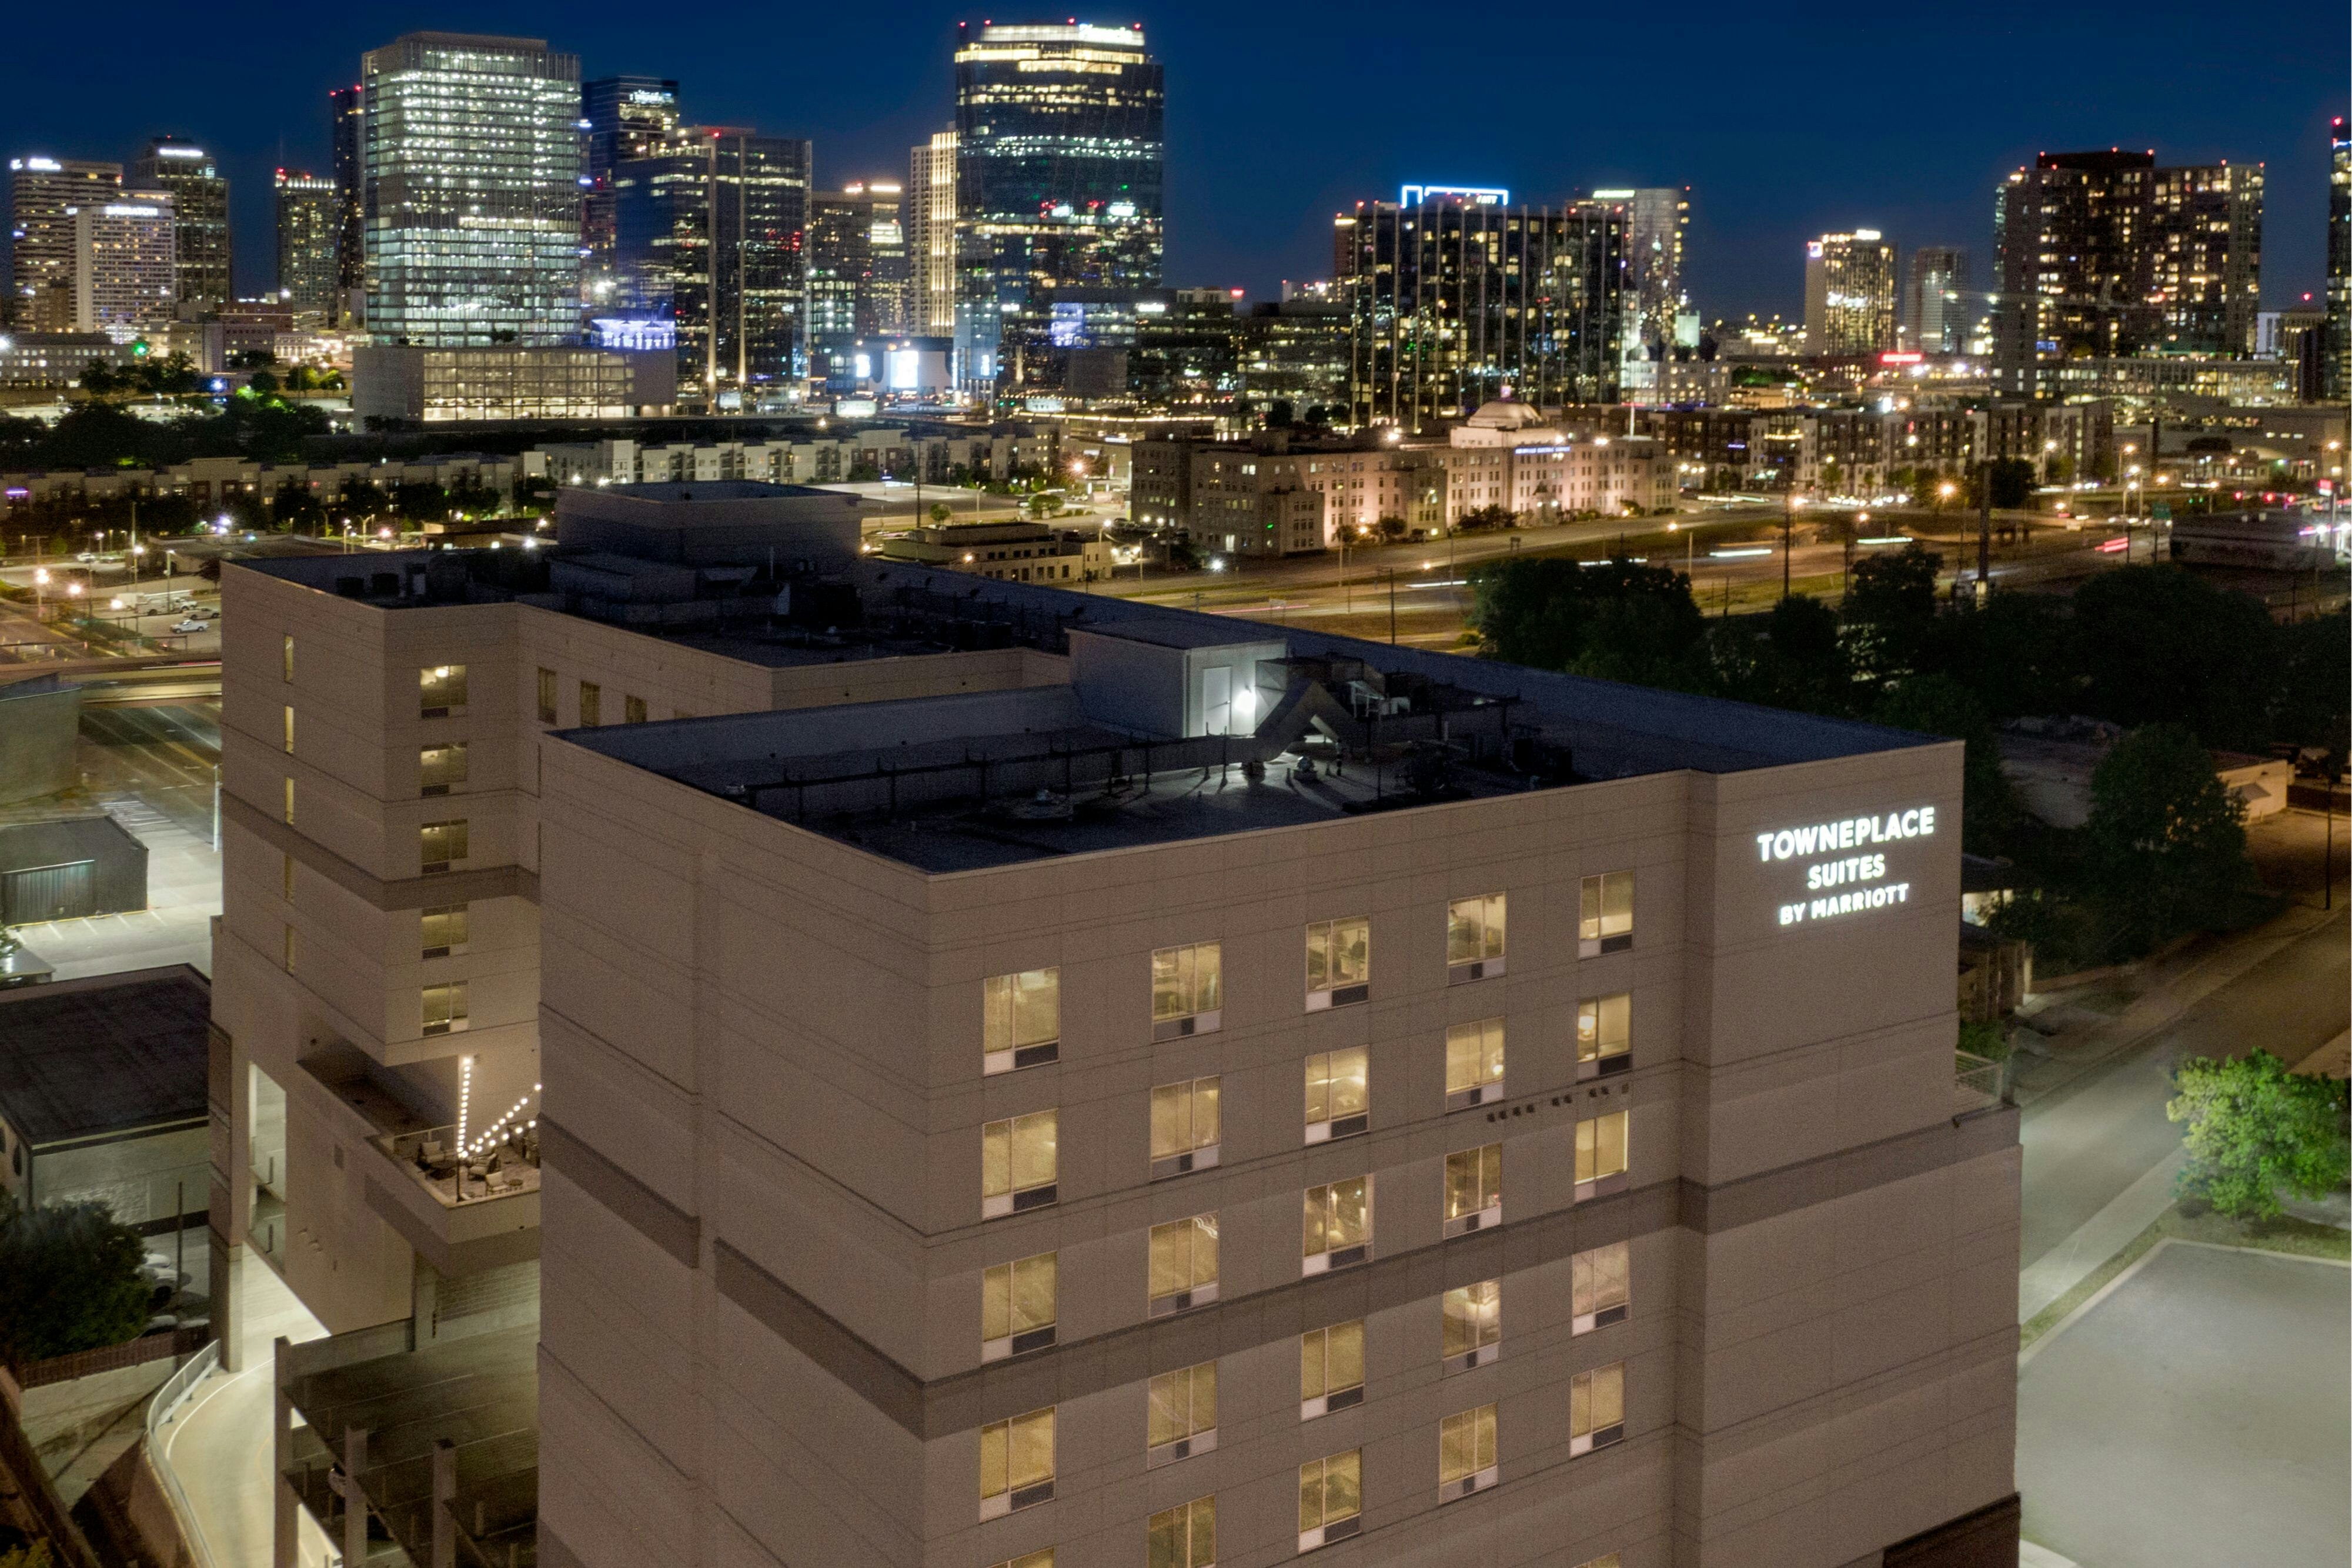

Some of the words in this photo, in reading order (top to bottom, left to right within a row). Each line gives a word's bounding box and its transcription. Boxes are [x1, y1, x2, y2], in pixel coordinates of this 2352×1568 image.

[1757, 807, 1935, 862] TOWNEPLACE
[1808, 854, 1886, 890] SUITES
[1779, 902, 1806, 925] BY
[1811, 883, 1909, 920] MARRIOTT
